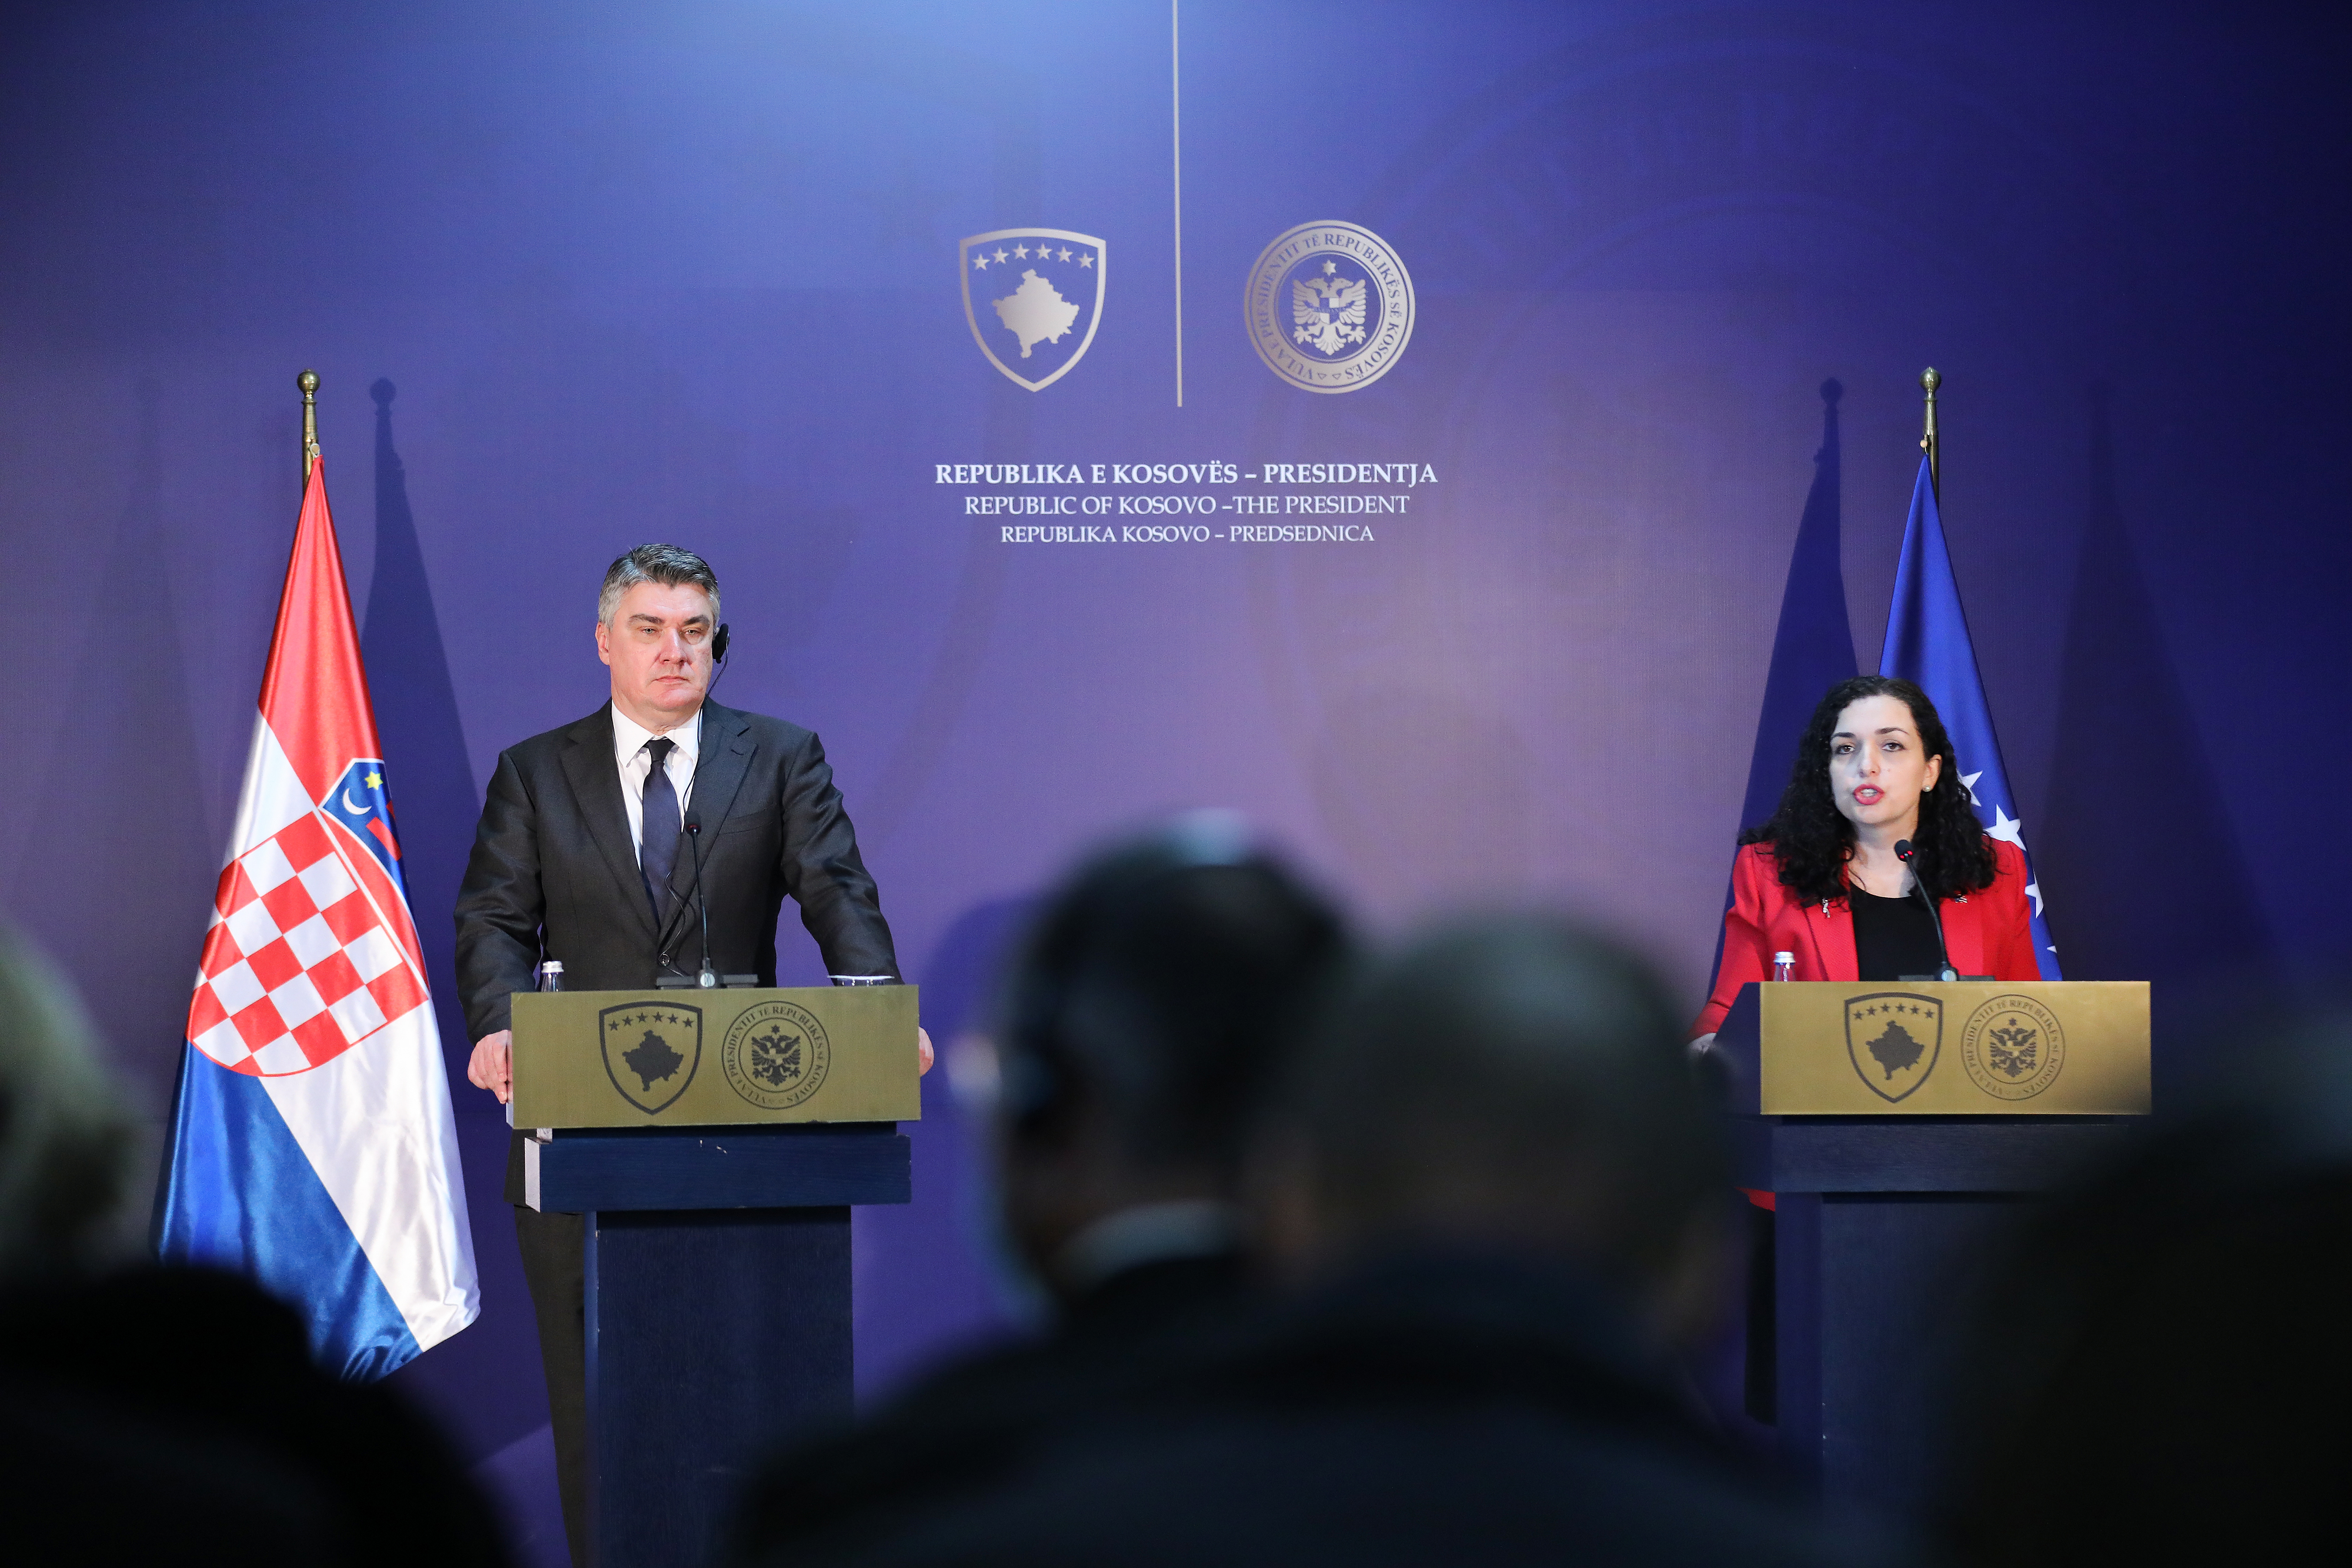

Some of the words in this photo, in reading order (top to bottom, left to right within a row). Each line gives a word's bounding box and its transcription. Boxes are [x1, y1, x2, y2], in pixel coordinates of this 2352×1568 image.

[1324, 233, 1402, 299] REPUBLIKËS
[1345, 322, 1399, 379] KOSOVËS
[935, 463, 1085, 484] REPUBLIKA
[1091, 464, 1106, 484] E
[1112, 462, 1238, 484] KOSOVËS
[1263, 463, 1438, 488] PRESIDENTJA
[965, 496, 1077, 515] REPUBLIC
[1081, 496, 1112, 515] OF
[1118, 496, 1217, 514] KOSOVO
[1285, 495, 1410, 514] PRESIDENT
[1001, 526, 1117, 543] REPUBLIKA
[1122, 526, 1210, 543] KOSOVO
[1230, 525, 1375, 542] PREDSEDNICA
